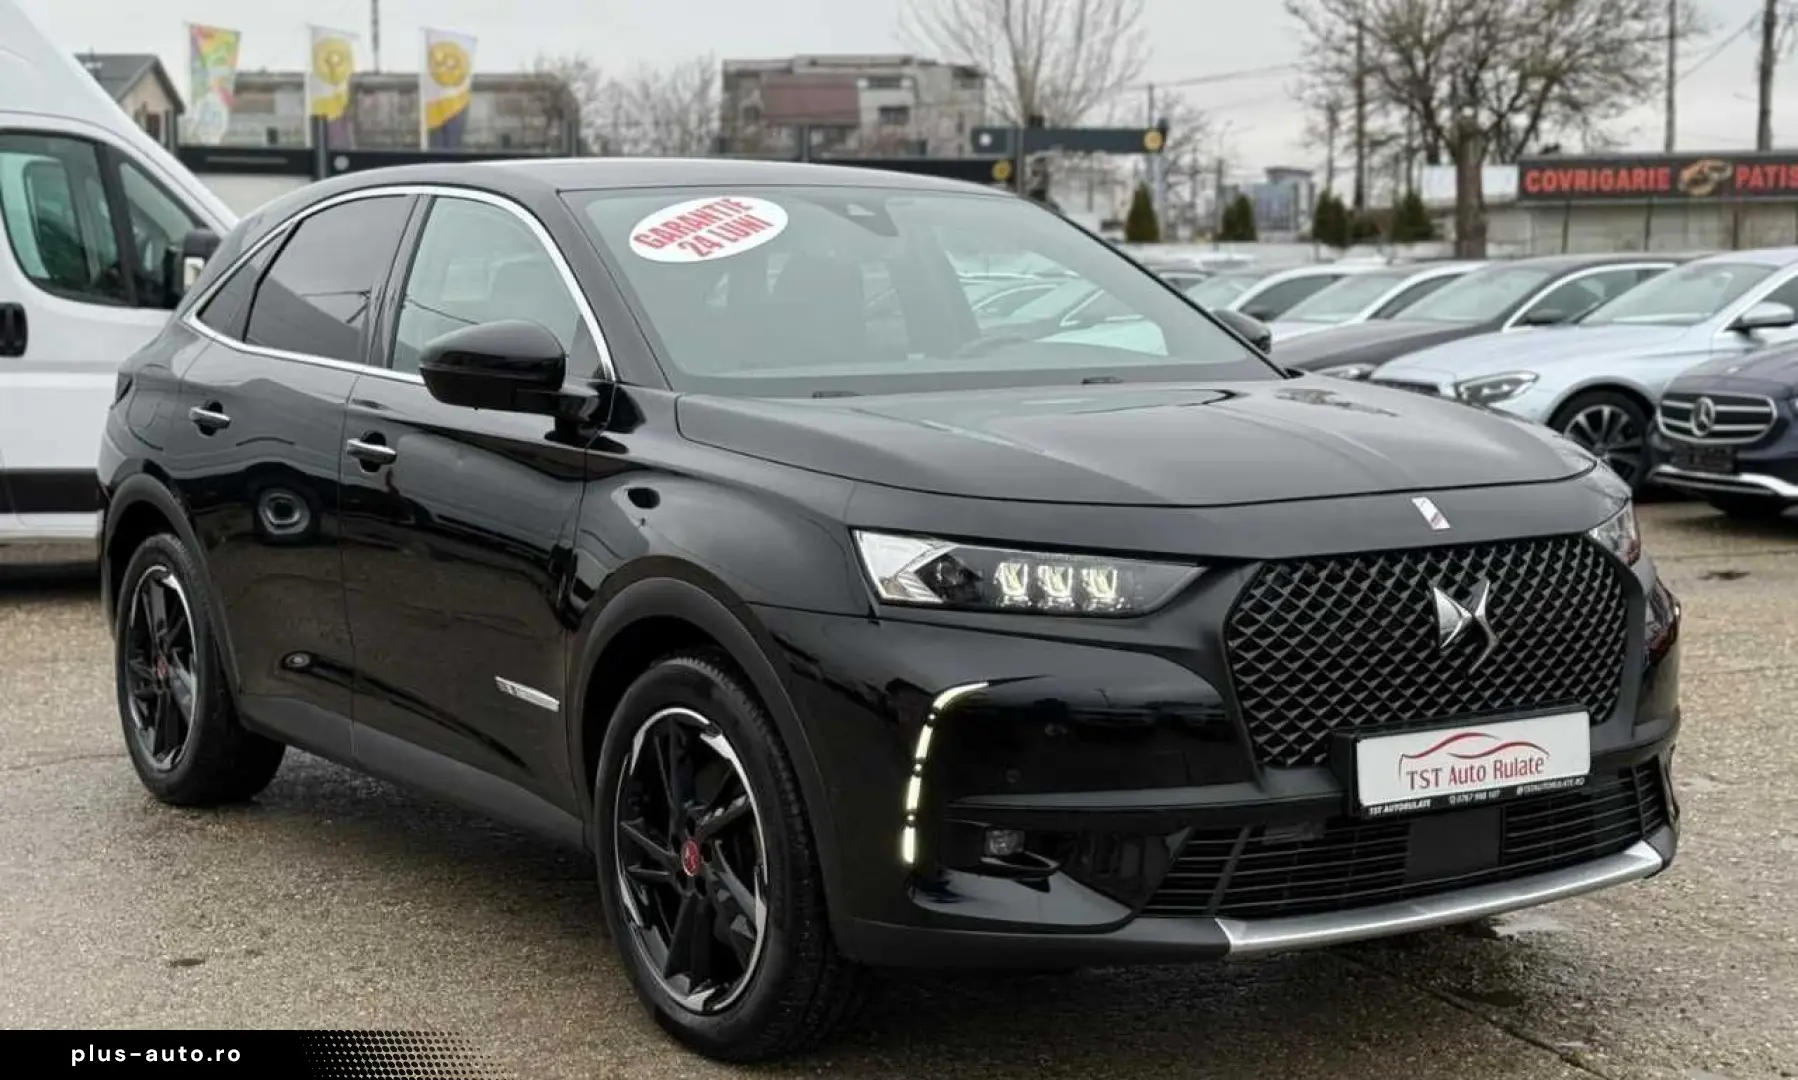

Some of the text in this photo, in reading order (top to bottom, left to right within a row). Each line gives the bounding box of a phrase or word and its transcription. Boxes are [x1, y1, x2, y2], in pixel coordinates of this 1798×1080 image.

[1525, 166, 1671, 193] COVRIGARIE
[633, 198, 753, 249] GARANTIE
[677, 214, 773, 257] 24 LUNI
[1406, 757, 1545, 790] TST Auto Rulate
